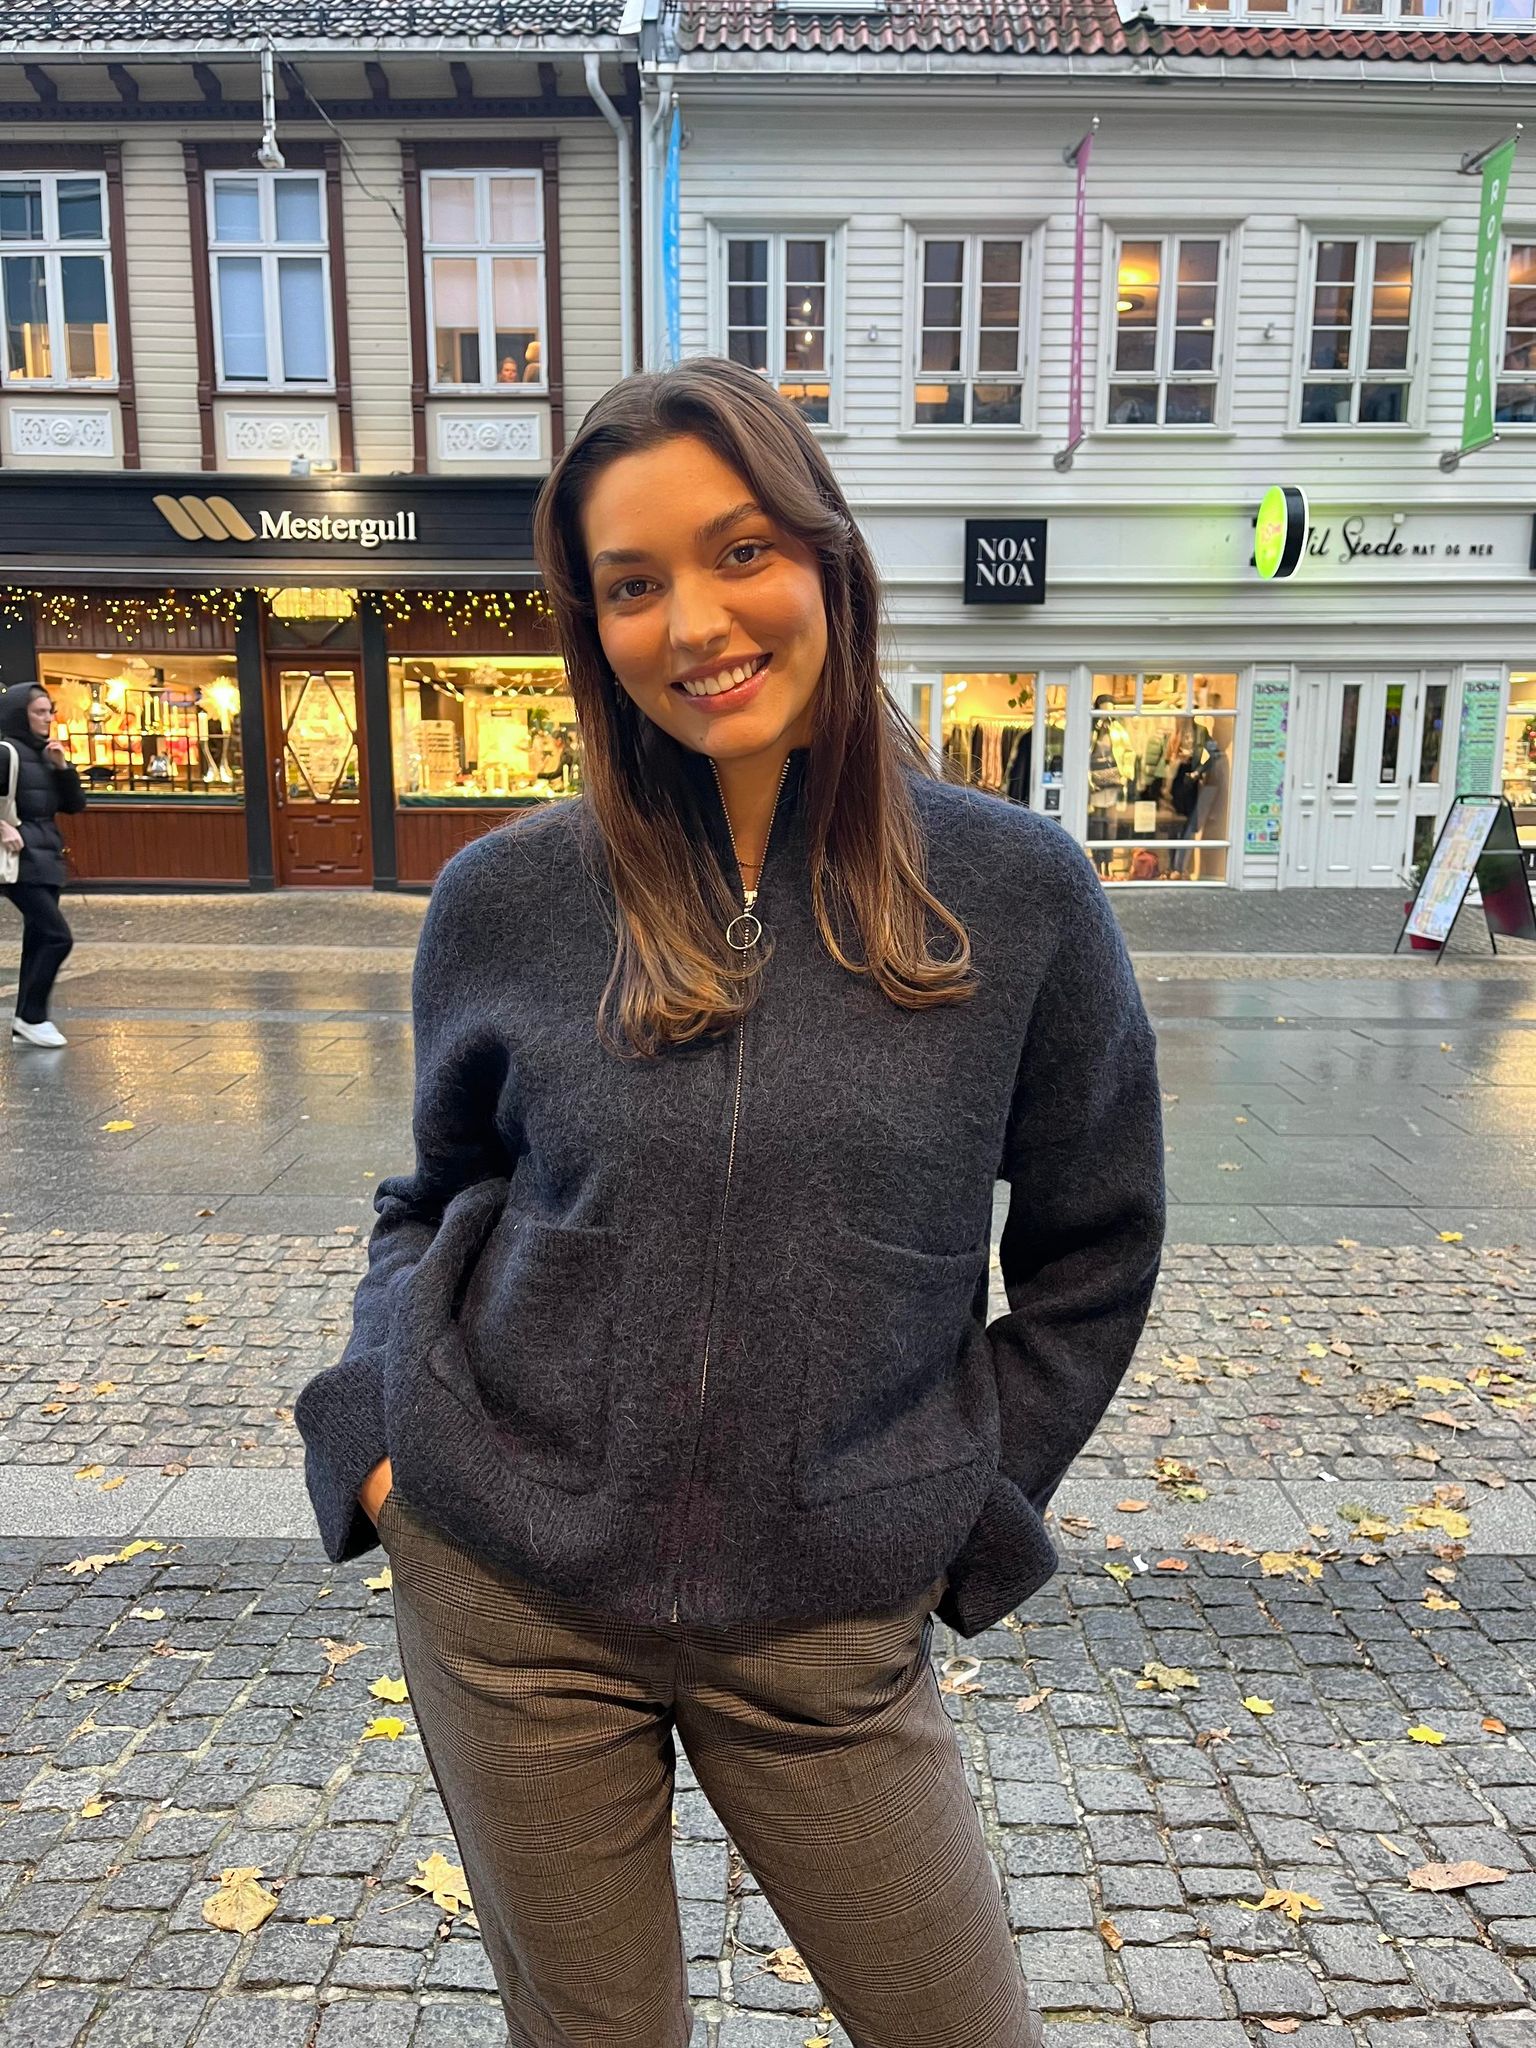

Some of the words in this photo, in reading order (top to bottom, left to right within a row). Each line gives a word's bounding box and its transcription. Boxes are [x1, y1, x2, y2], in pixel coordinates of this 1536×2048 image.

[1473, 178, 1500, 418] ROOFTOP
[259, 510, 417, 548] Mestergull
[1339, 515, 1407, 564] Stede
[976, 537, 1035, 561] NOA
[1412, 544, 1434, 555] MAT
[1445, 544, 1460, 556] OG
[1469, 544, 1493, 556] MER
[976, 562, 1034, 586] NOA
